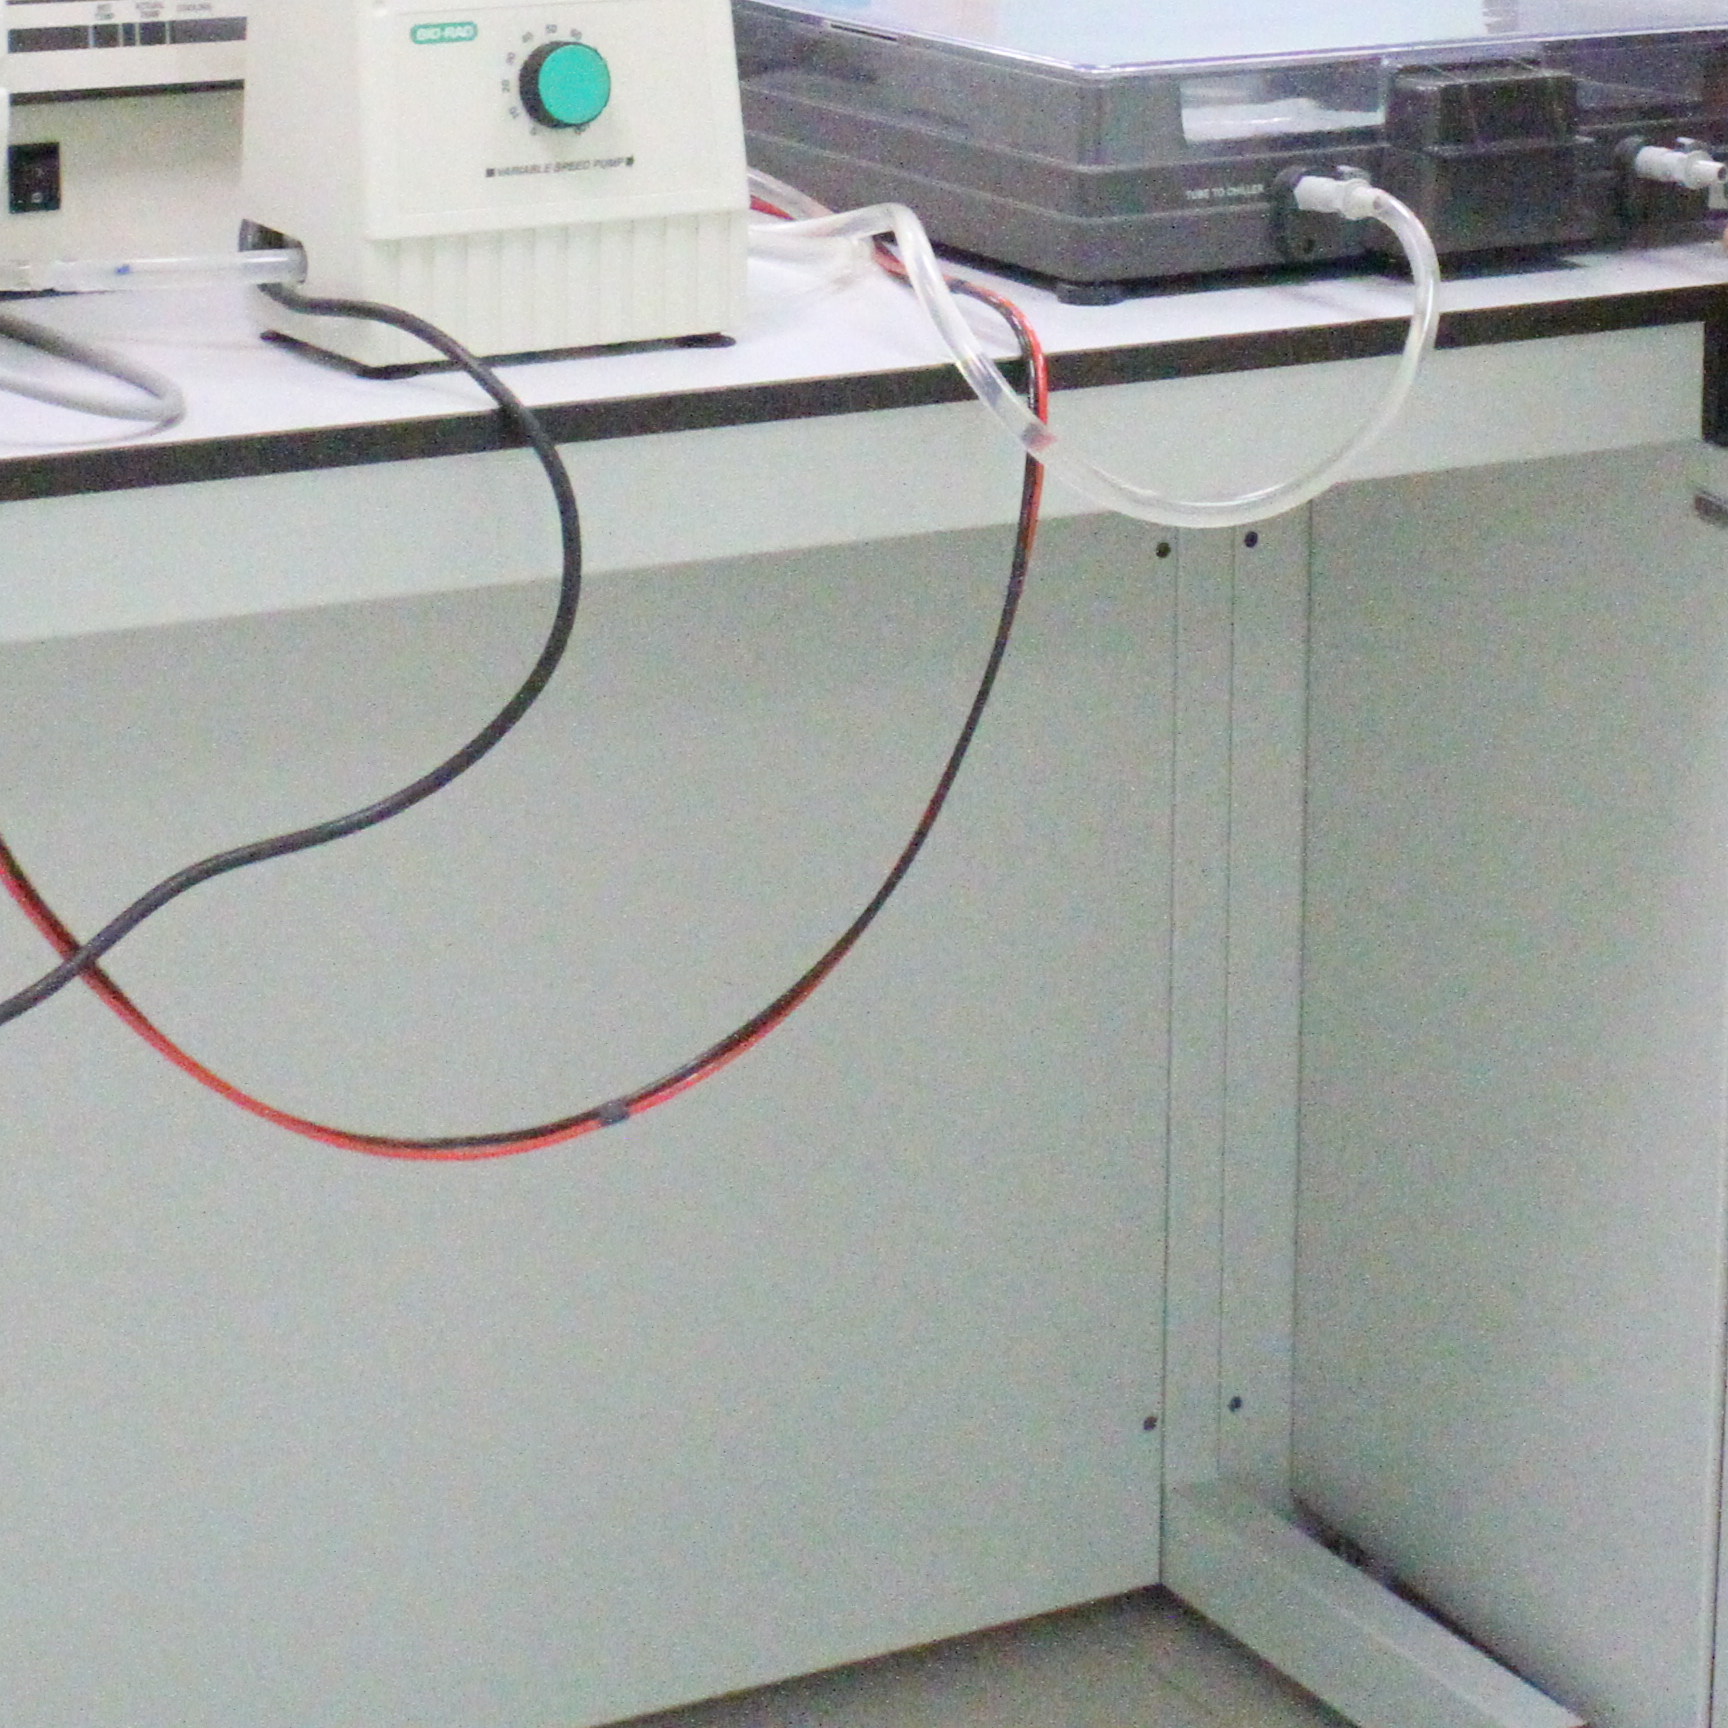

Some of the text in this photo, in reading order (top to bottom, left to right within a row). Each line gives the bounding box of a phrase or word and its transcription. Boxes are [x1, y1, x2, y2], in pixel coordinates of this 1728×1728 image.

[416, 25, 474, 41] BIO-RAD
[498, 163, 551, 176] VARIABLE
[553, 159, 590, 173] SPEED
